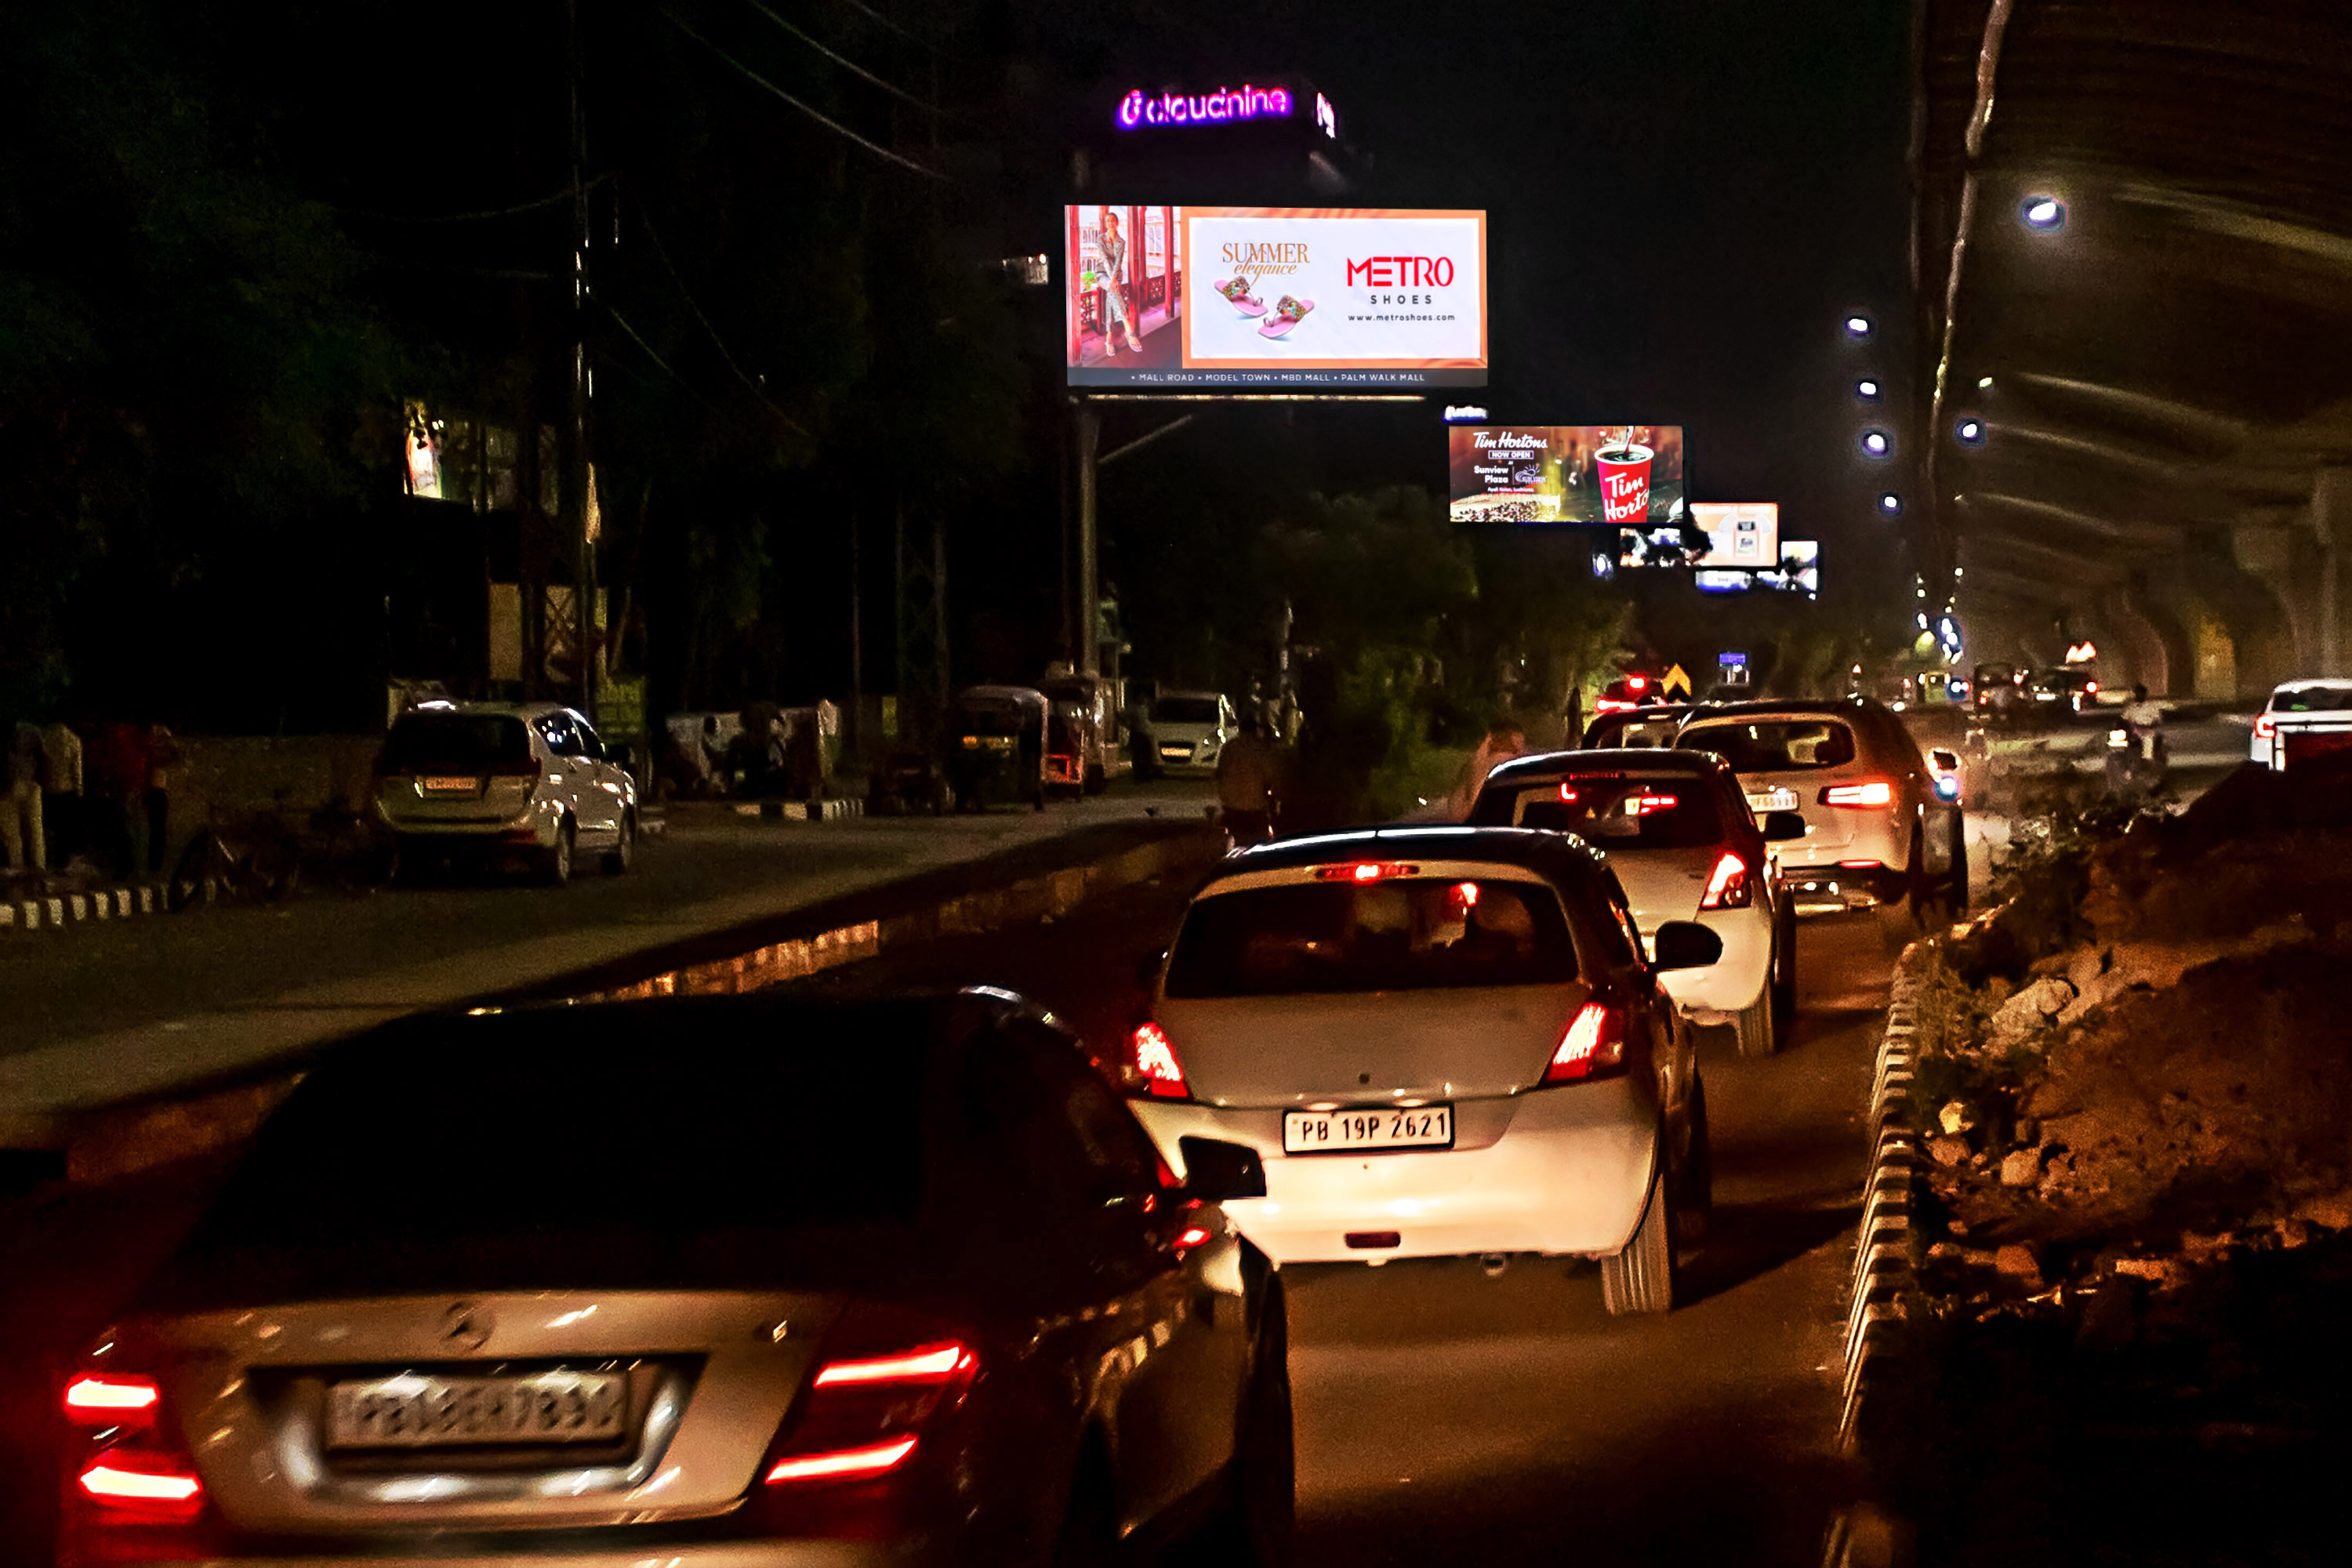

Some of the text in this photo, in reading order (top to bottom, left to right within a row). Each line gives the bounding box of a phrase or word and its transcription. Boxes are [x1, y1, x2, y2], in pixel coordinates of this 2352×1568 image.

[1222, 243, 1310, 263] SUMMER
[1234, 249, 1298, 287] elegance
[1347, 256, 1454, 287] METRO
[1370, 295, 1432, 304] SHOES
[1473, 432, 1497, 448] Tim
[1605, 472, 1643, 498] Tim
[1302, 1112, 1445, 1142] PB 19P 2621
